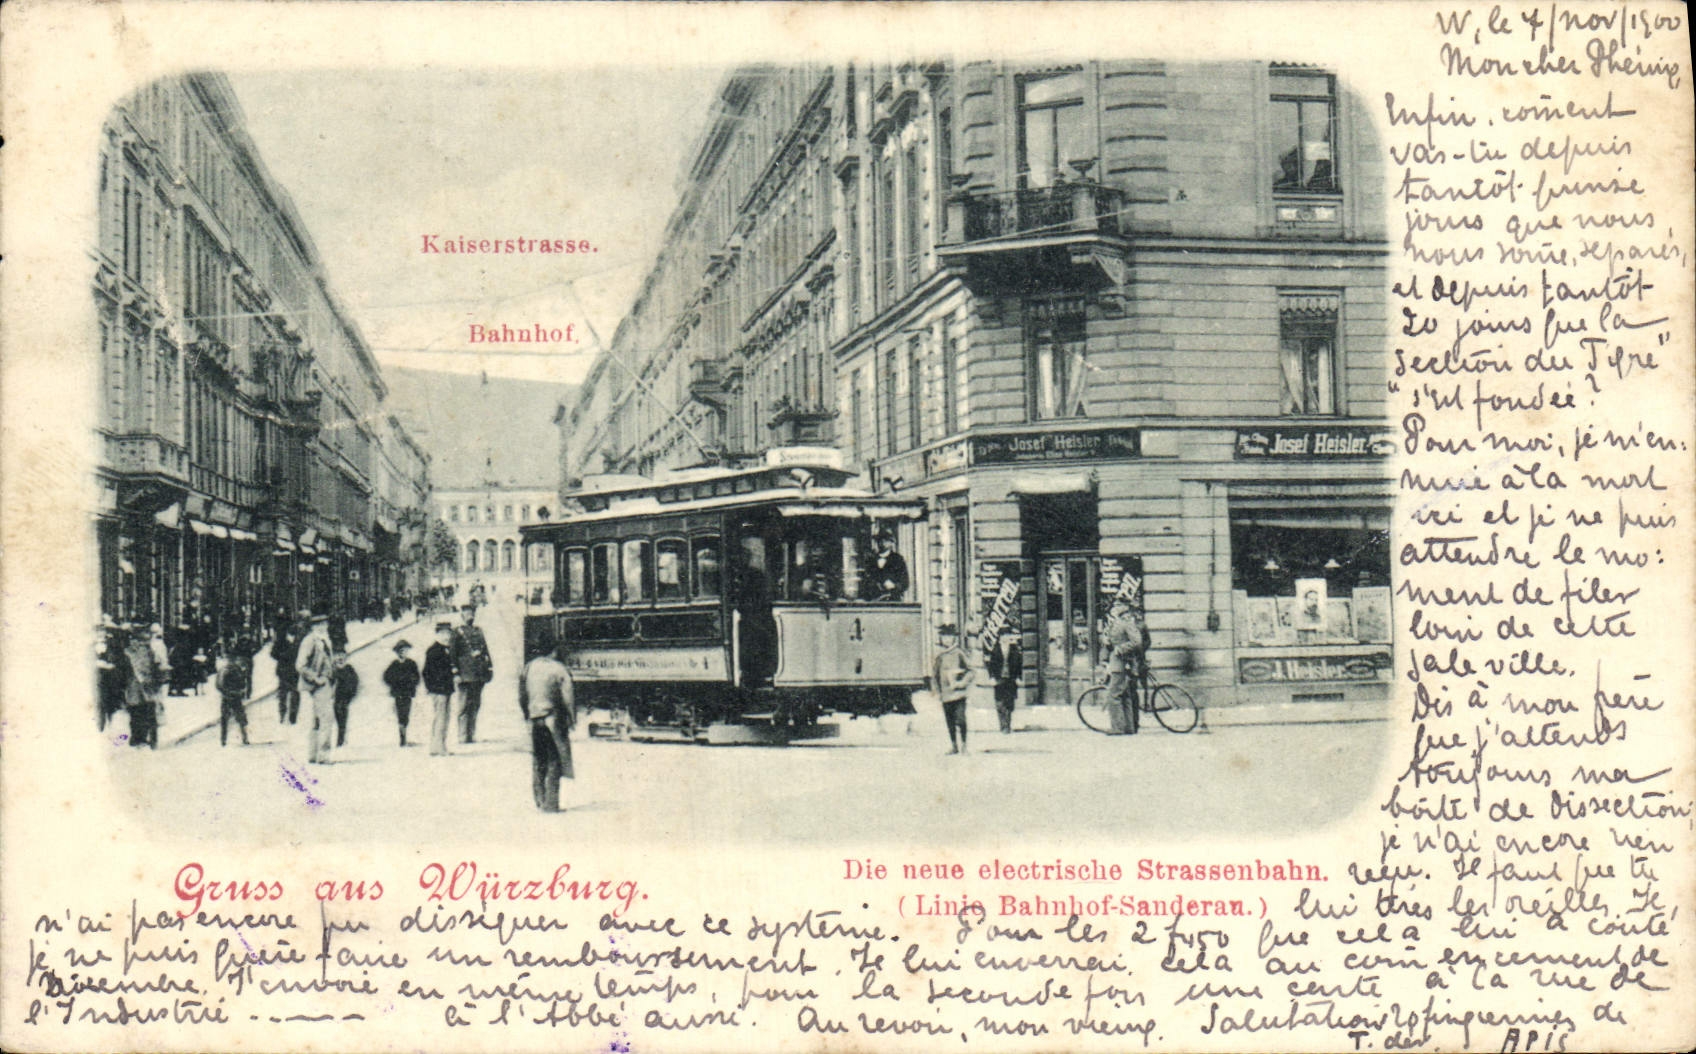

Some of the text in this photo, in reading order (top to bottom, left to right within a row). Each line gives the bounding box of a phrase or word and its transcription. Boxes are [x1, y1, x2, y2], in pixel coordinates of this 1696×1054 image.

[1488, 4, 1513, 34] le
[1521, 135, 1632, 175] depuis
[1405, 209, 1483, 248] jours
[1506, 214, 1562, 243] que
[1404, 243, 1484, 266] nous
[1392, 275, 1422, 300] et
[1431, 275, 1528, 312] depuis
[1453, 309, 1531, 361] jours
[1544, 308, 1587, 350] que
[1525, 348, 1573, 372] du
[1009, 435, 1046, 451] Josef
[1054, 435, 1101, 450] Heisler
[1269, 433, 1309, 454] Josef
[1402, 412, 1476, 455] Pour
[1574, 425, 1598, 461] je
[1581, 465, 1667, 491] mort
[1412, 497, 1676, 544] ici et je ne puis
[1400, 532, 1540, 568] attendre
[1553, 532, 1585, 564] le
[1396, 568, 1640, 625] ment de filer
[1409, 609, 1636, 642] loin de cette
[1502, 693, 1578, 716] mon
[1414, 723, 1467, 767] que
[1398, 761, 1673, 811] toujours ma
[1488, 794, 1534, 822] de
[1496, 833, 1589, 855] encore
[1574, 853, 1615, 894] que
[1630, 855, 1660, 882] tu
[1295, 887, 1359, 919] lui
[128, 899, 184, 945] pas
[197, 911, 296, 929] encore
[599, 912, 686, 937] avec
[703, 913, 731, 936] ce
[1055, 914, 1108, 942] les
[1131, 921, 1156, 944] 2
[1258, 918, 1309, 958] que
[1451, 916, 1517, 939] lui
[26, 939, 49, 987] je
[64, 948, 112, 967] ne
[124, 938, 199, 976] puis
[427, 946, 492, 967] un
[902, 944, 961, 974] lui
[1265, 957, 1321, 974] au
[1631, 944, 1668, 966] de
[398, 979, 445, 999] en
[742, 968, 819, 1011] pour
[852, 970, 900, 1001] la
[928, 977, 1072, 1006] seconde
[1174, 982, 1263, 1006] une
[1288, 976, 1382, 998] carte
[1472, 964, 1508, 990] la
[1530, 969, 1596, 991] rue
[1610, 963, 1670, 991] de
[798, 1006, 849, 1033] Au
[974, 1017, 1049, 1036] mon
